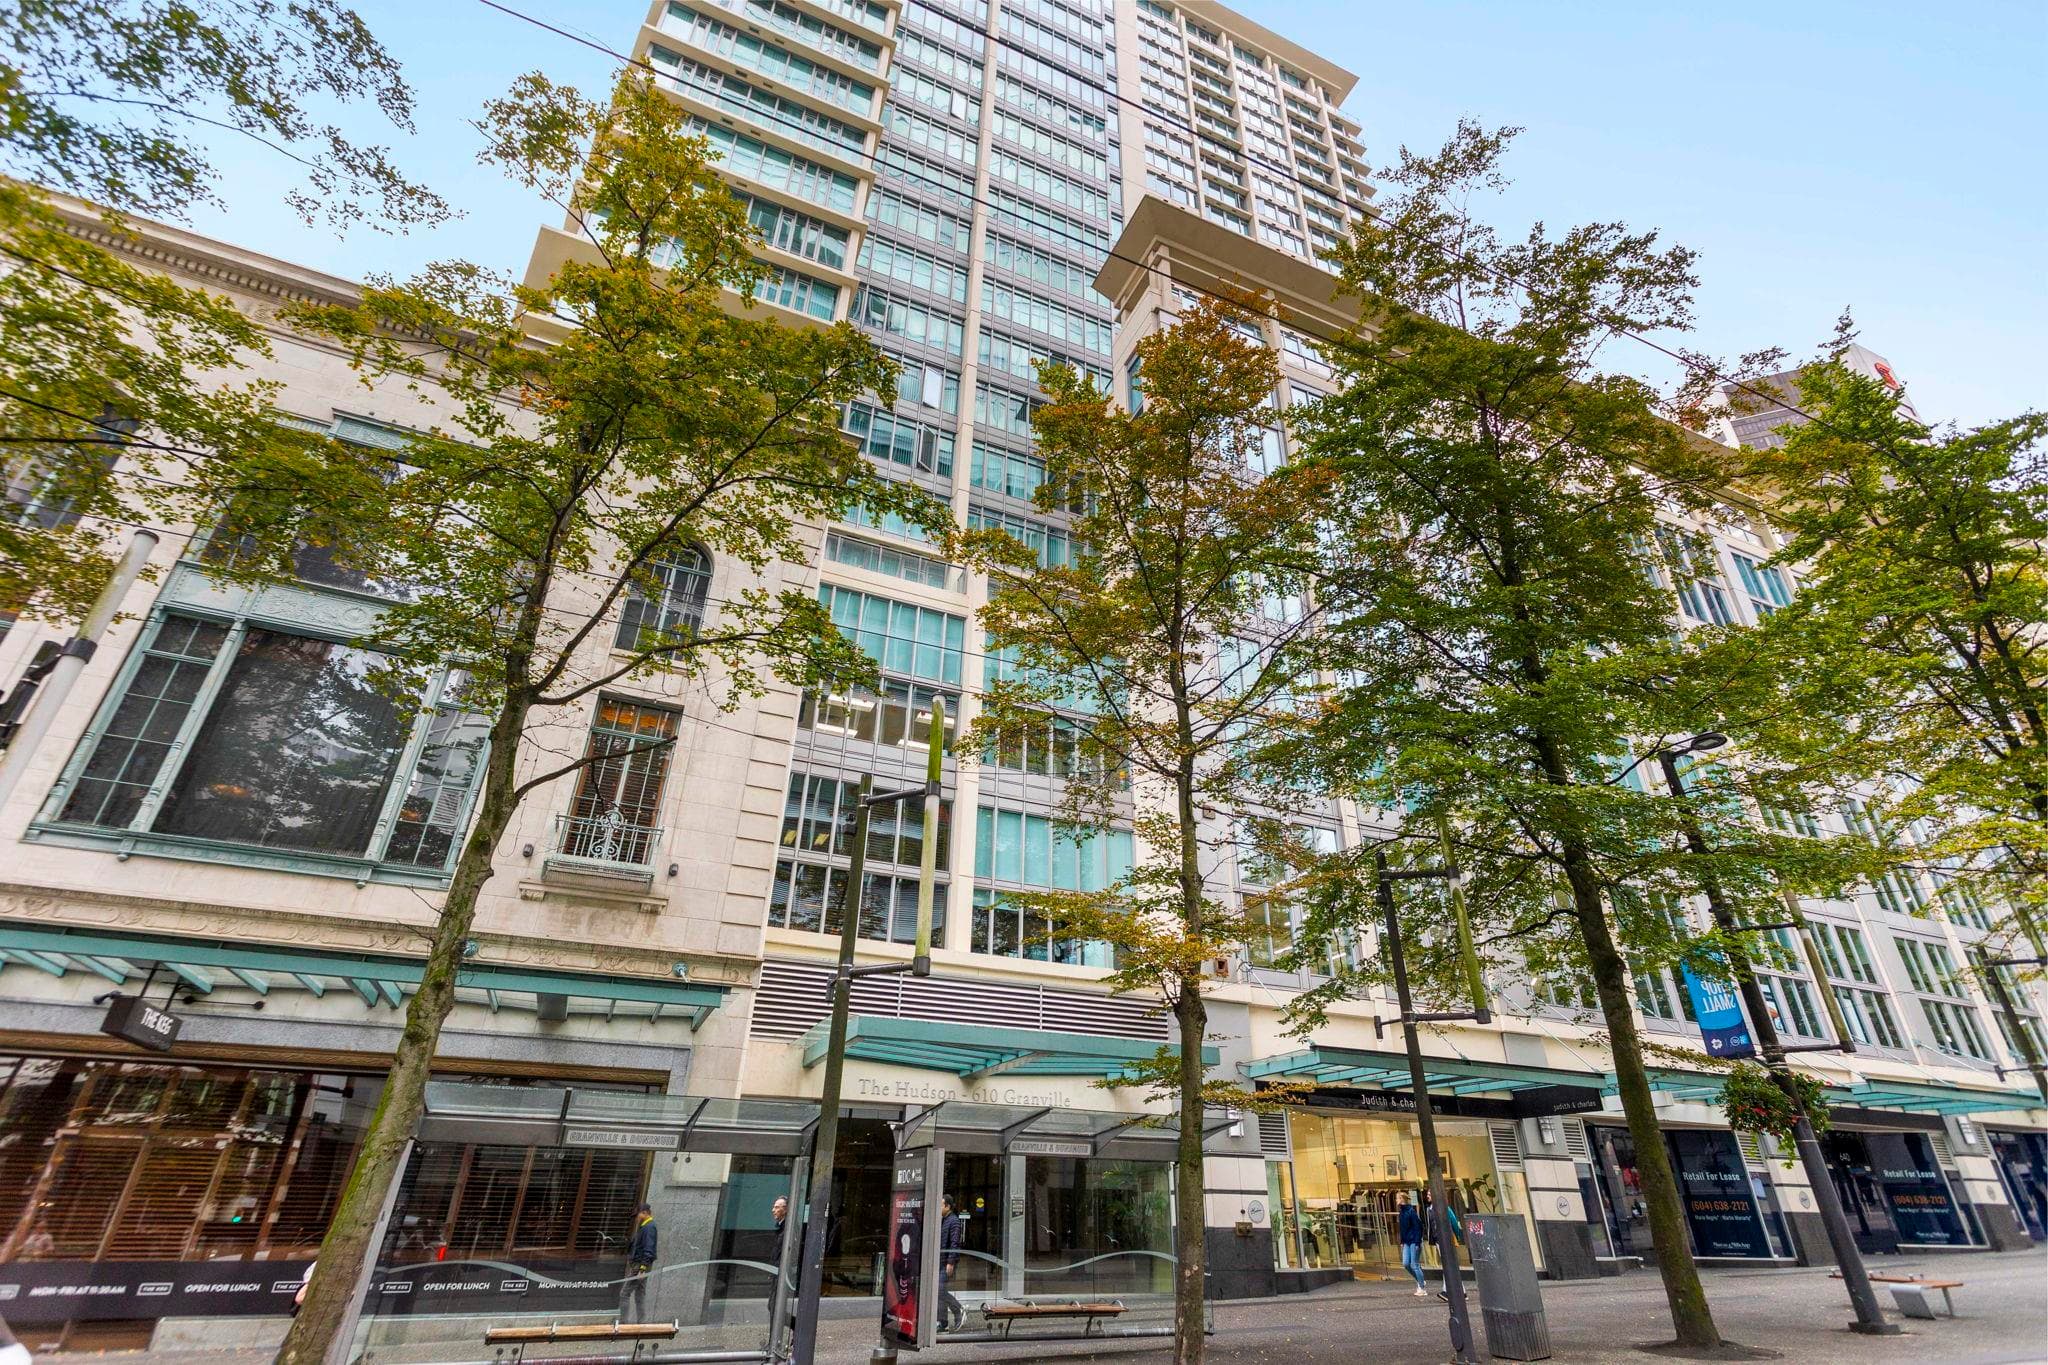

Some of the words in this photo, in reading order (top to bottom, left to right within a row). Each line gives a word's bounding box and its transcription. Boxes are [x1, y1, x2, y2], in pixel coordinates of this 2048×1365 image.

[140, 1007, 161, 1029] THE
[155, 1013, 174, 1035] KEG
[859, 1078, 890, 1097] The
[895, 1081, 956, 1101] Hudson
[972, 1086, 998, 1103] 610
[1004, 1089, 1072, 1107] Granville
[1361, 1094, 1388, 1107] Judith
[1391, 1097, 1397, 1107] &
[1400, 1097, 1418, 1108] char
[569, 1131, 618, 1144] GRANVILLE
[1683, 1171, 1704, 1182] Retail
[1705, 1171, 1719, 1181] For
[1720, 1171, 1740, 1181] Lease
[1883, 1169, 1904, 1178] Retail
[1904, 1170, 1916, 1178] For
[1916, 1170, 1936, 1178] Lease
[184, 1284, 211, 1293] OPEN
[210, 1284, 229, 1293] FOR
[229, 1283, 261, 1292] LUNCH
[423, 1282, 446, 1291] OPEN
[446, 1282, 463, 1291] FOR
[463, 1282, 490, 1290] LUNCH
